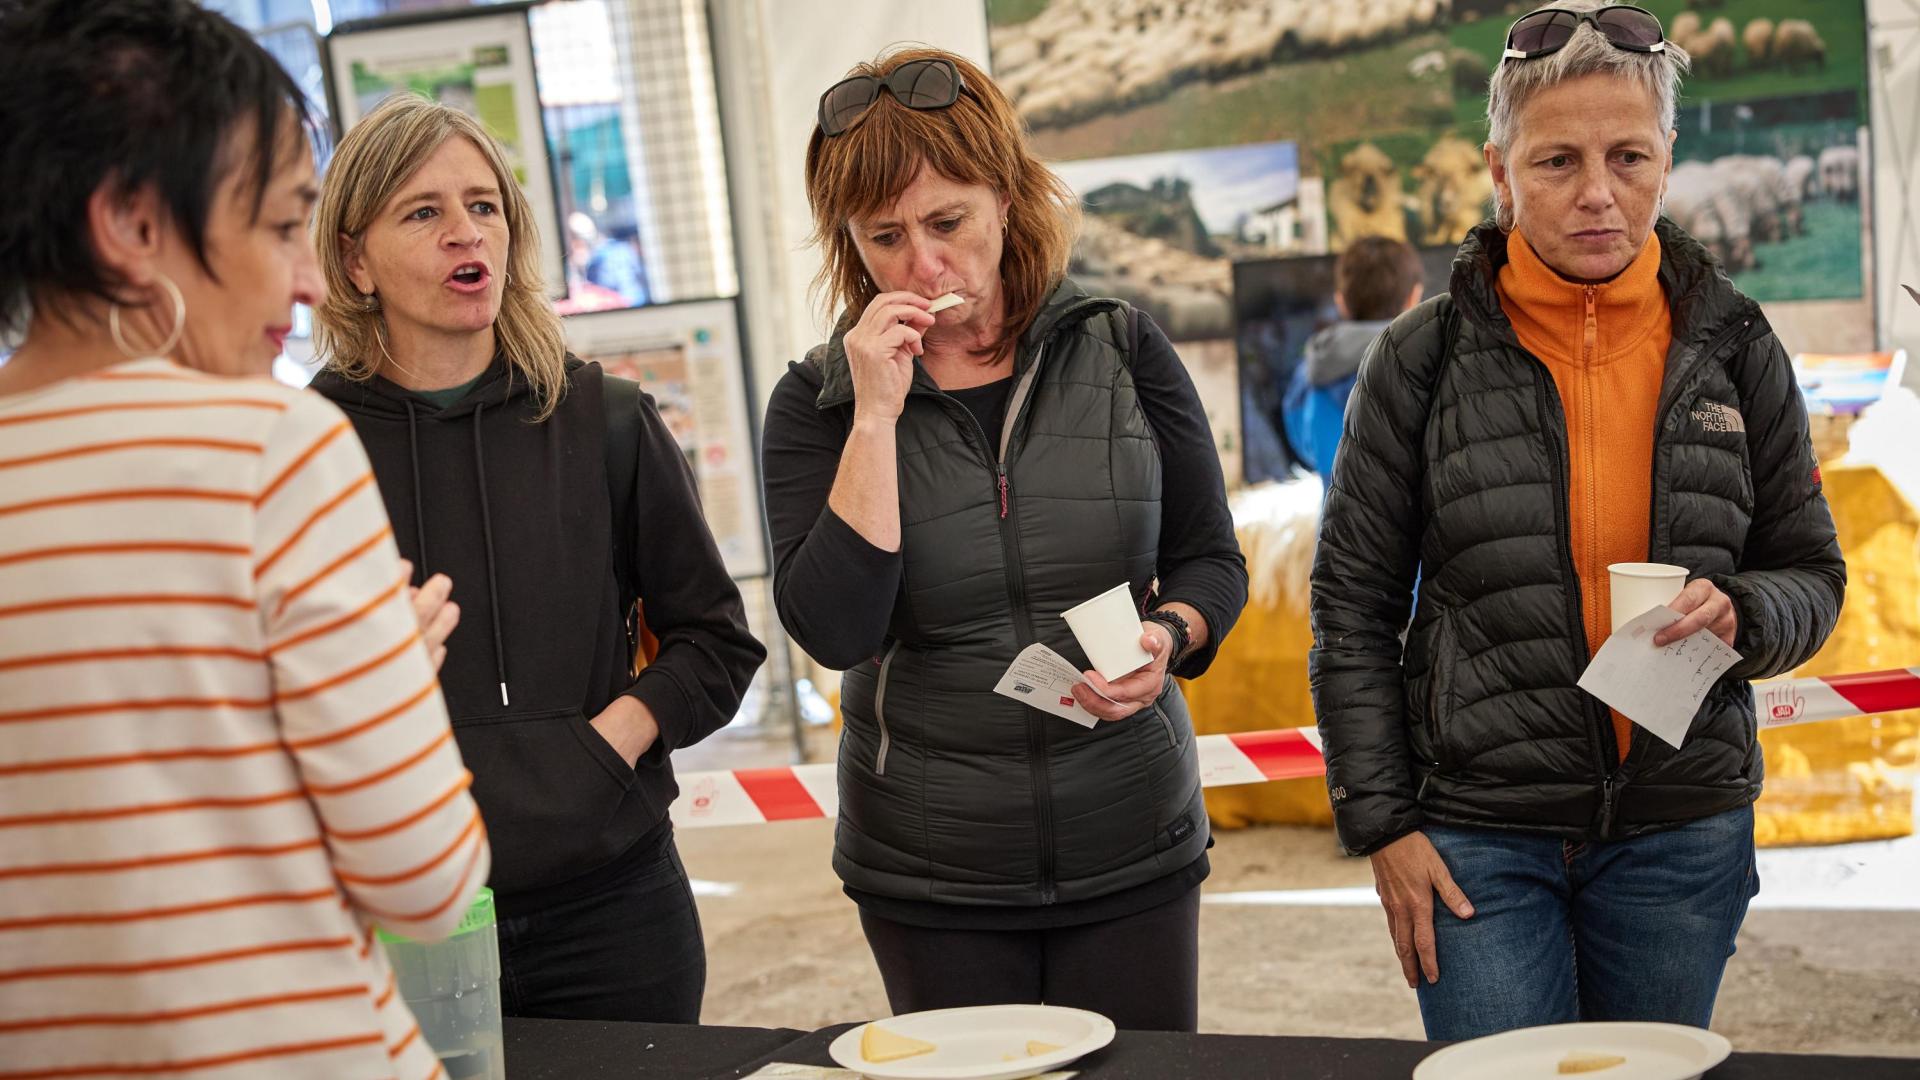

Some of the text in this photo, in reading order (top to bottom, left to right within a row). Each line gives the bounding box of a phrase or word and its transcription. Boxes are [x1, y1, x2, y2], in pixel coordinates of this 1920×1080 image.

[1705, 402, 1722, 414] THE
[1692, 411, 1725, 423] NORTH
[1703, 421, 1726, 432] FACE
